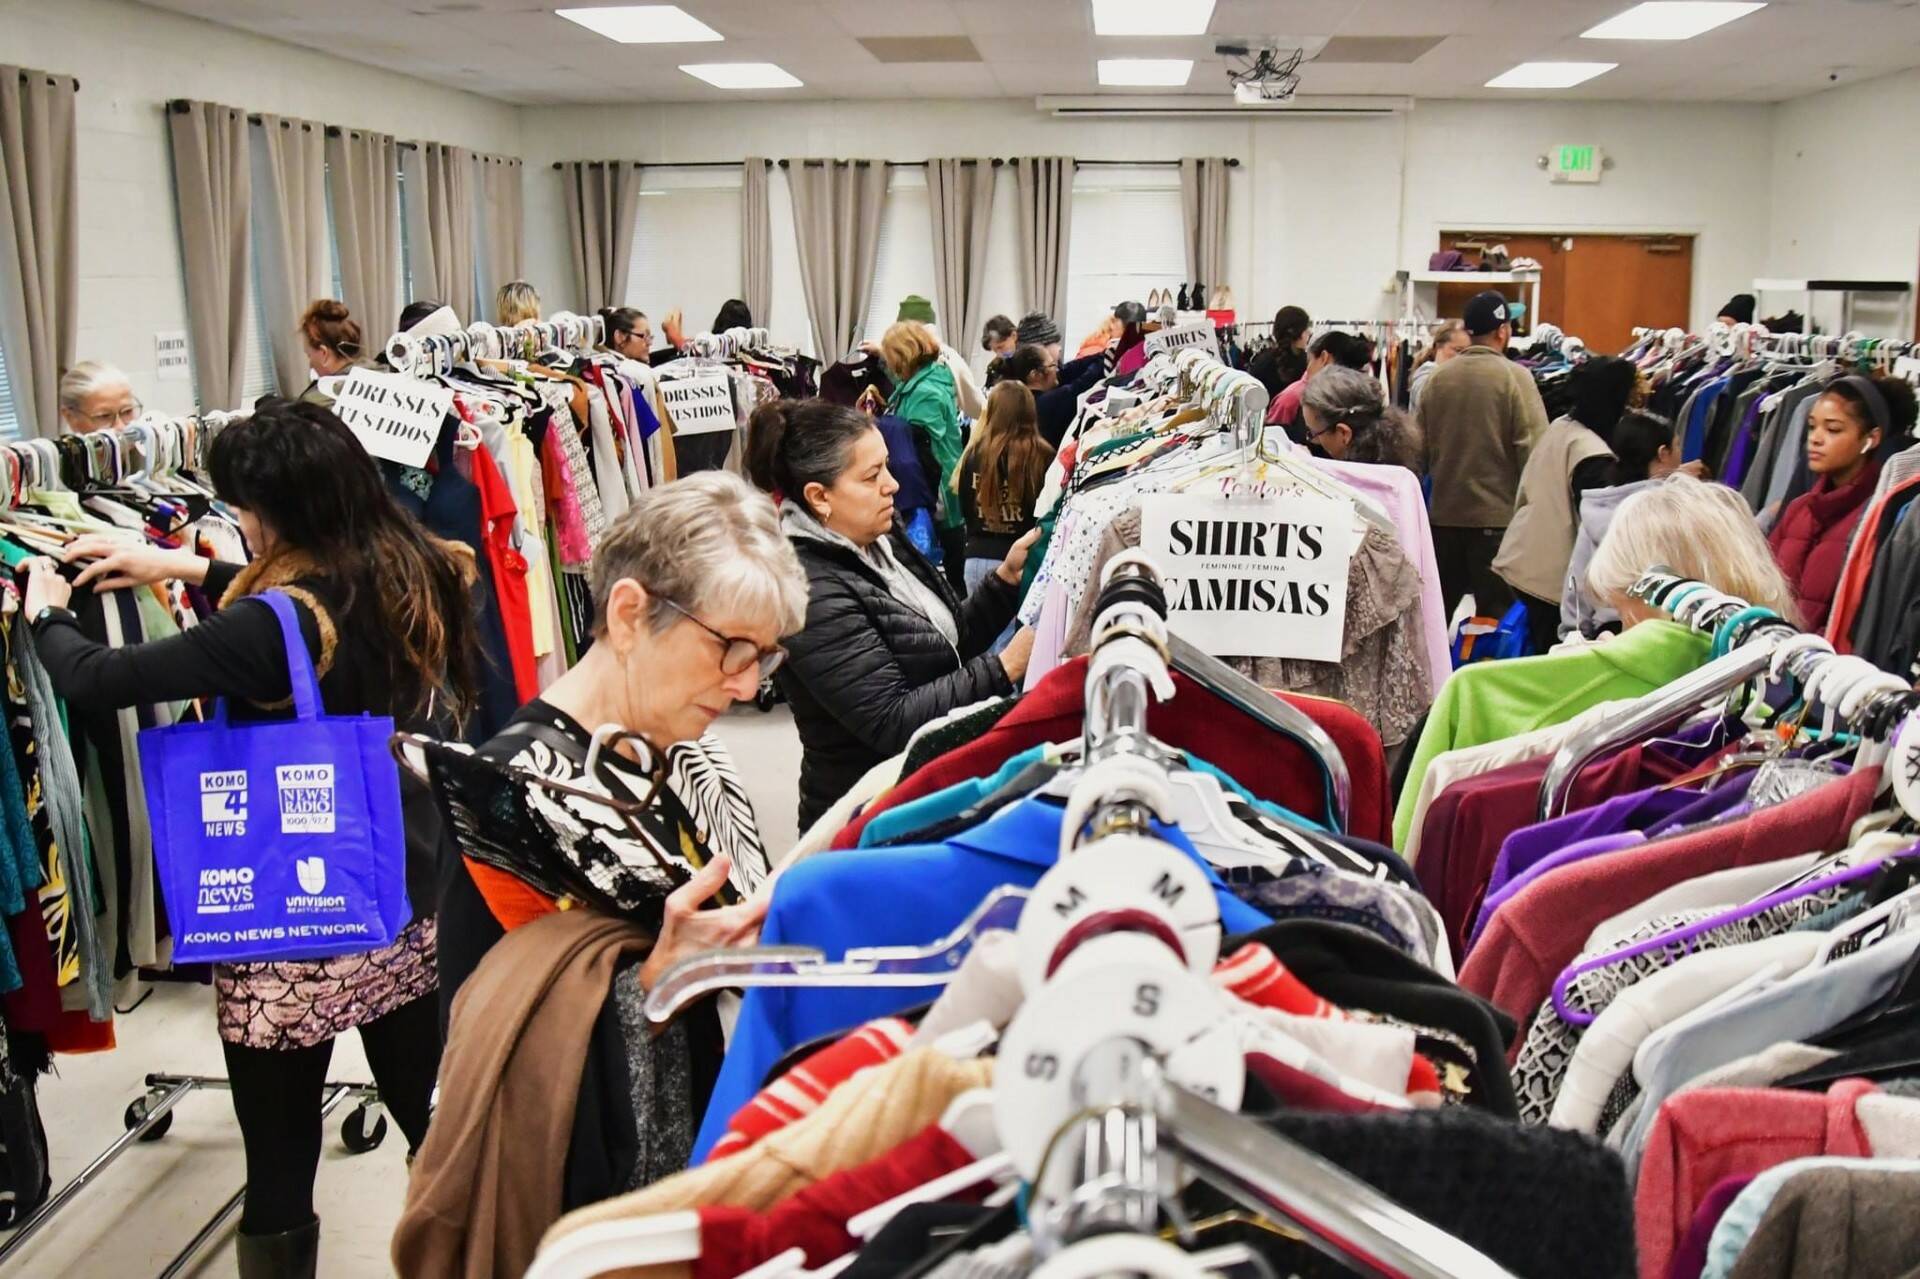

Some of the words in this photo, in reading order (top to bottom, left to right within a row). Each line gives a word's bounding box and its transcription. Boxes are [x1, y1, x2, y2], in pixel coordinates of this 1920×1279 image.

[1560, 144, 1594, 172] EXIT
[1161, 330, 1207, 348] HIRTS
[348, 380, 441, 418] DRESSES
[664, 385, 727, 403] DRESSES
[671, 404, 732, 421] ESTIDOS
[1169, 519, 1323, 561] SHIRTS
[1200, 562, 1243, 571] FEMININE
[1252, 564, 1286, 573] FEMINA
[205, 774, 245, 788] KOMO
[281, 769, 329, 781] KOMO
[224, 790, 245, 815] 4
[284, 789, 330, 801] NEWS
[284, 800, 331, 814] RADIO
[206, 821, 246, 837] NEWS
[200, 867, 255, 886] KOMO
[198, 884, 254, 905] news
[183, 932, 231, 944] KOMO
[234, 926, 285, 942] NEWS
[288, 922, 369, 938] NETWORK
[1132, 983, 1162, 1018] S
